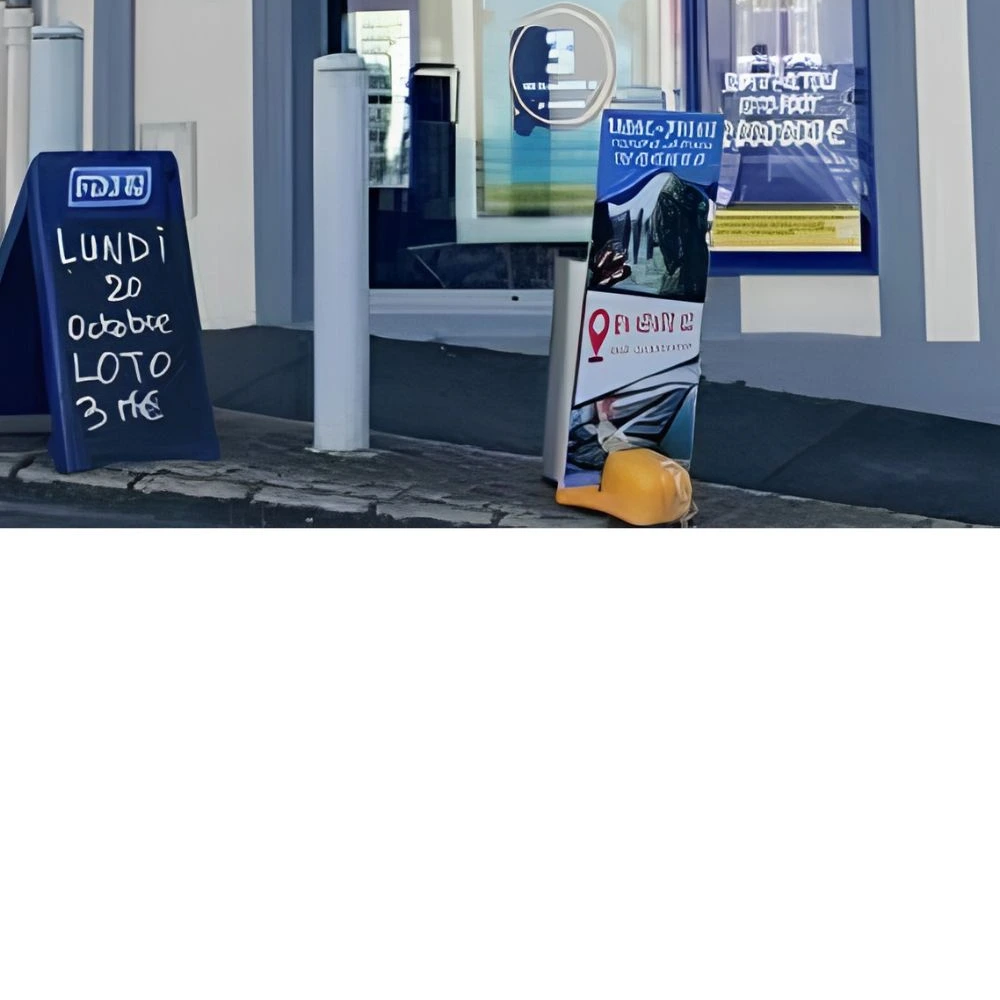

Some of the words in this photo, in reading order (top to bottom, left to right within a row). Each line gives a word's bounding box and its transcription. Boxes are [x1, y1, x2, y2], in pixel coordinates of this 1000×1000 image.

[104, 274, 142, 302] 20
[73, 351, 172, 385] LOTO
[75, 395, 108, 431] 3
